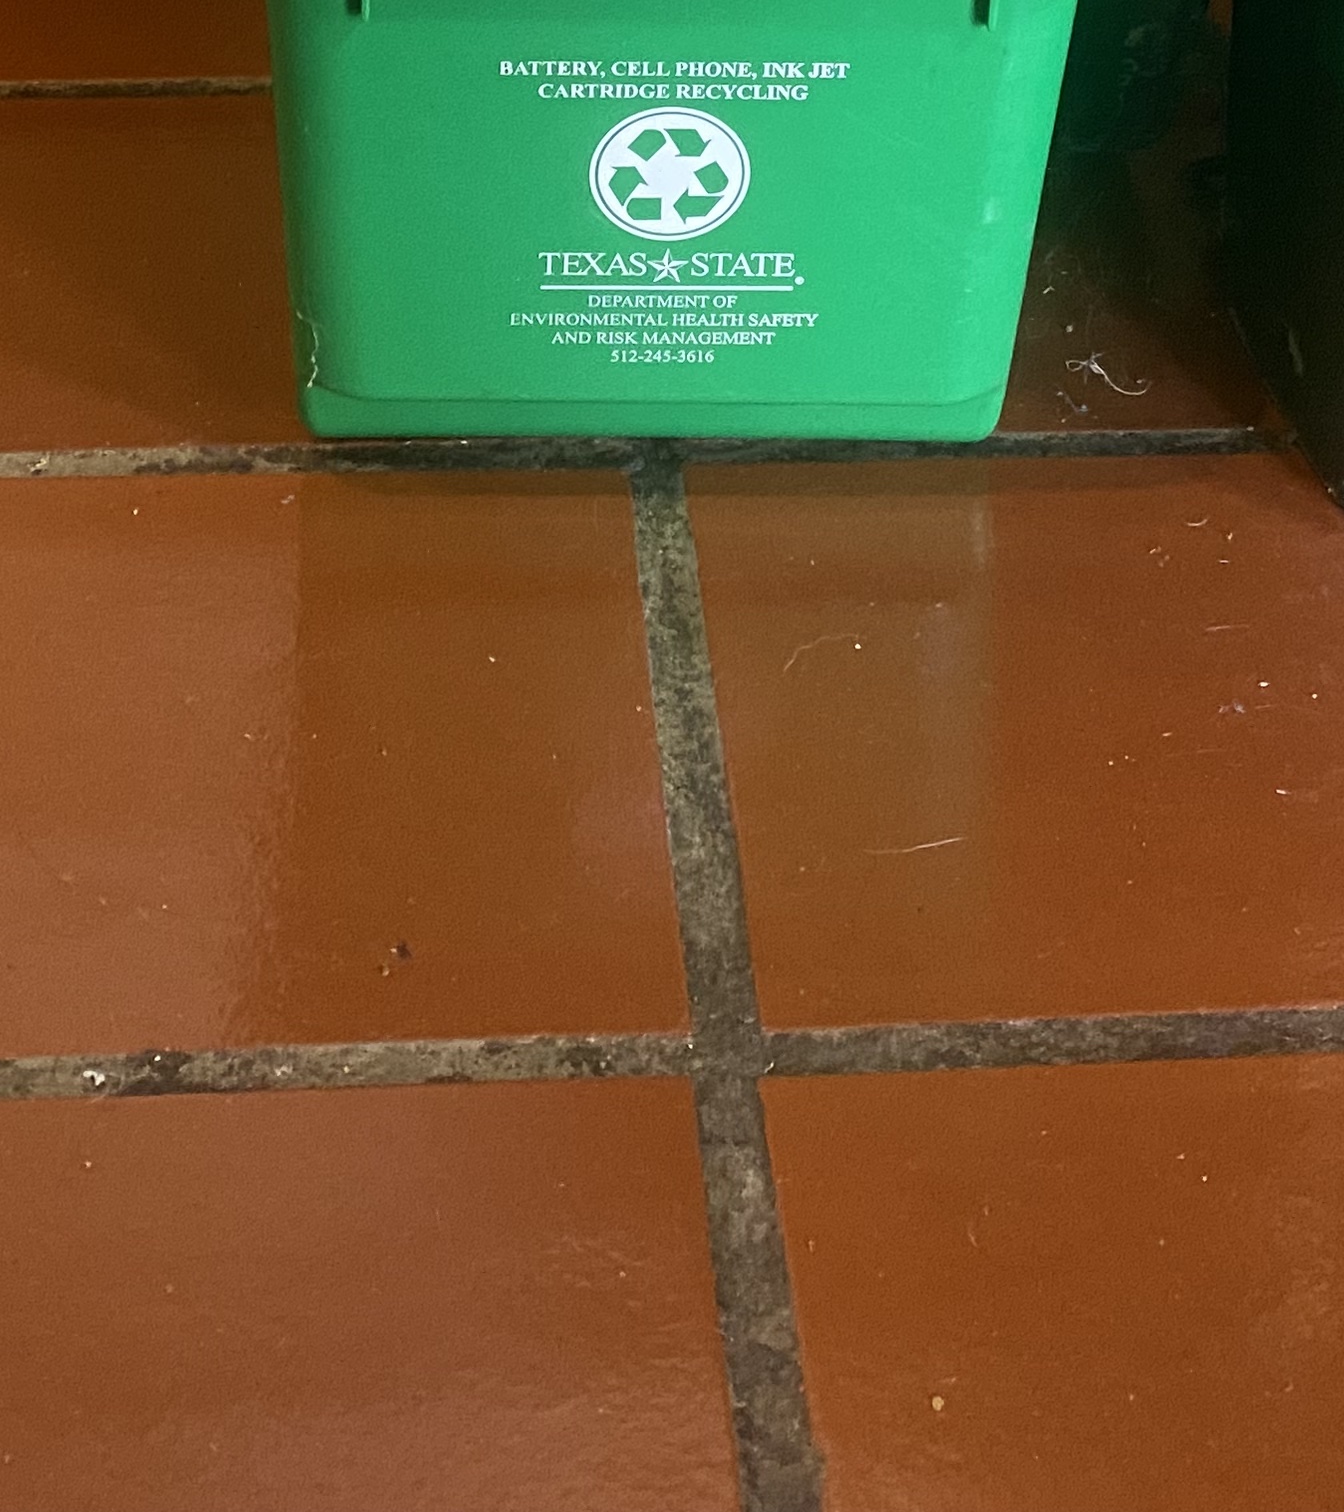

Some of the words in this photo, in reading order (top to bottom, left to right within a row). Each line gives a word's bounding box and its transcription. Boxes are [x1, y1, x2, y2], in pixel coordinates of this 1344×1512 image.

[499, 60, 606, 78] BATTERY,
[611, 61, 671, 77] CELL
[675, 61, 757, 80] PHONE,
[762, 62, 805, 78] INK
[808, 62, 851, 79] JET
[537, 83, 670, 99] CARTRIDGE
[676, 84, 809, 100] RECYCLING
[538, 252, 647, 276] TEXAS
[588, 295, 710, 308] DEPARTMENT
[712, 295, 738, 308] OF
[510, 313, 668, 327] ENVIRONMENTAL
[672, 313, 744, 327] HEALTH
[748, 313, 819, 327] SAFETY
[551, 331, 592, 345] AND
[596, 331, 638, 345] RISK
[642, 331, 776, 345] MANAGEMENT
[610, 349, 715, 363] 512-245-3616
